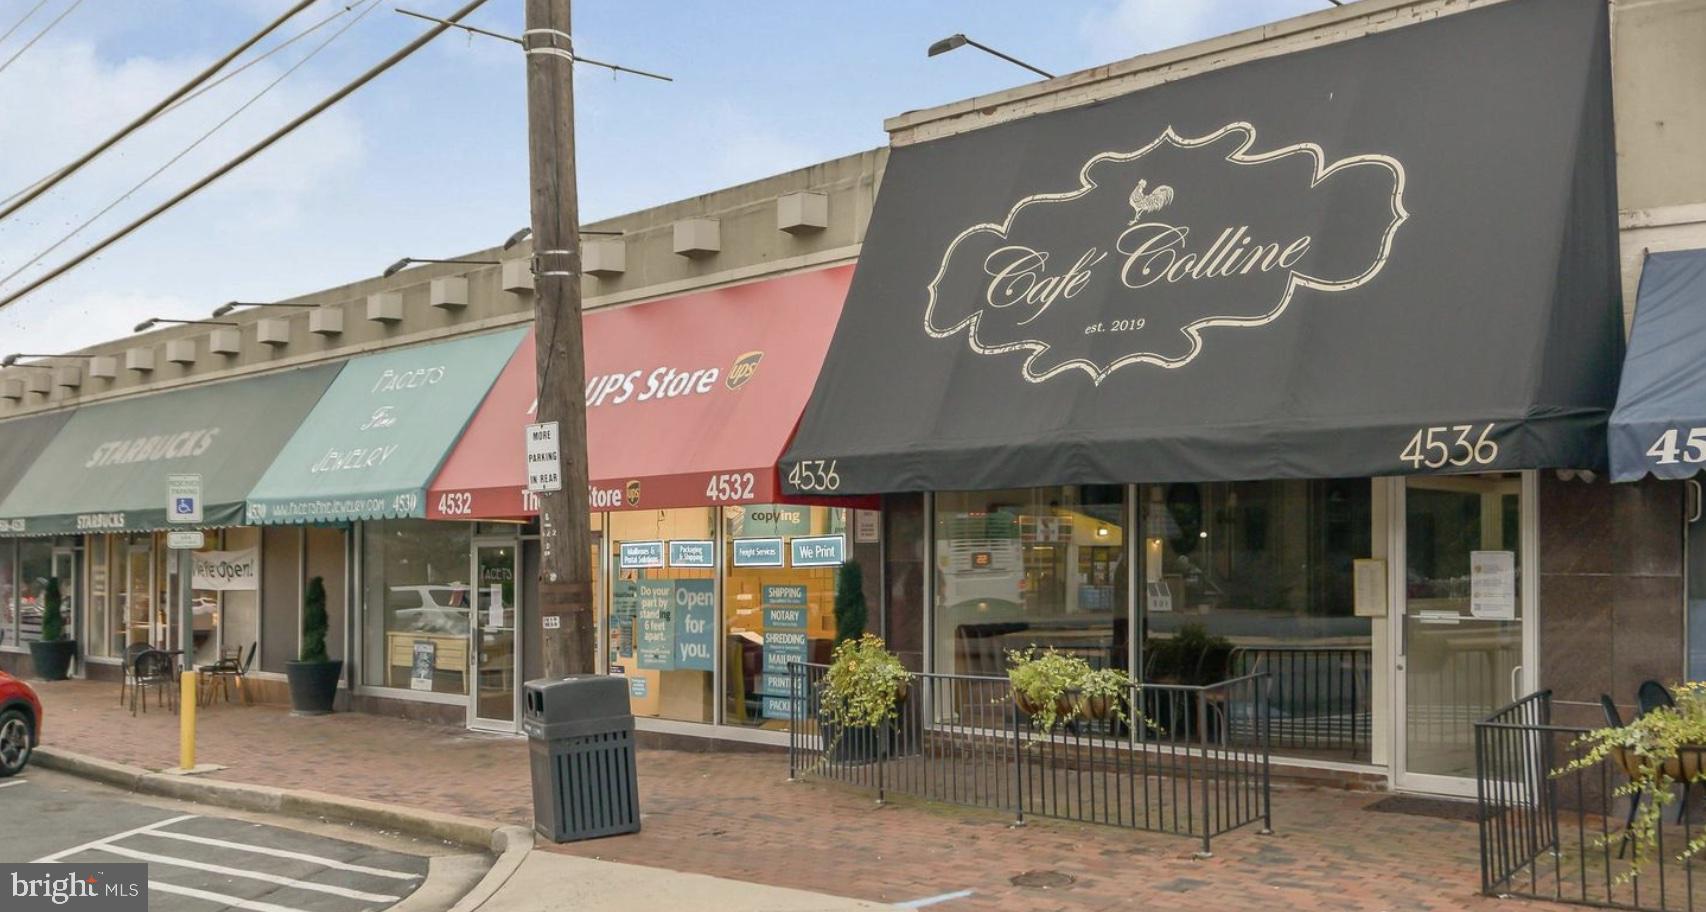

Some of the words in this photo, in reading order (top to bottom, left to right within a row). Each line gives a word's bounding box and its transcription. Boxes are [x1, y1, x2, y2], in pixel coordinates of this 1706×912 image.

[984, 245, 1108, 325] Café
[1116, 221, 1312, 289] Colline
[1084, 321, 1106, 336] est.
[1111, 318, 1146, 333] 2019
[371, 365, 447, 393] FACETS
[730, 361, 758, 385] ups
[585, 369, 643, 407] UPS
[638, 366, 720, 401] Store
[532, 430, 551, 441] MORE
[85, 427, 221, 468] STARBUCKS
[1399, 422, 1499, 469] 4536
[1646, 426, 1706, 465] 45
[311, 444, 399, 473] JEWELRY
[528, 451, 558, 463] PARKING
[530, 474, 538, 485] IN
[540, 473, 558, 484] REAR
[788, 459, 840, 490] 4536
[706, 472, 755, 501] 4532
[438, 492, 472, 515] 4532
[521, 489, 541, 511] Th
[77, 513, 125, 529] STARBUCKS
[751, 510, 801, 524] copying
[756, 547, 777, 556] Services
[799, 545, 813, 559] We
[815, 544, 836, 558] Print
[217, 558, 255, 582] Open!
[641, 586, 652, 596] Do
[652, 587, 670, 598] your
[676, 587, 714, 611] Open
[768, 587, 802, 598] SHIPPING
[641, 599, 657, 611] part
[659, 598, 668, 610] by
[640, 609, 671, 622] standing
[684, 613, 707, 634] for
[770, 609, 800, 621] NOTARY
[644, 621, 650, 631] 6
[650, 620, 665, 631] feet
[644, 631, 666, 643] apart.
[765, 632, 805, 645] SHREDDING
[680, 642, 710, 662] you.
